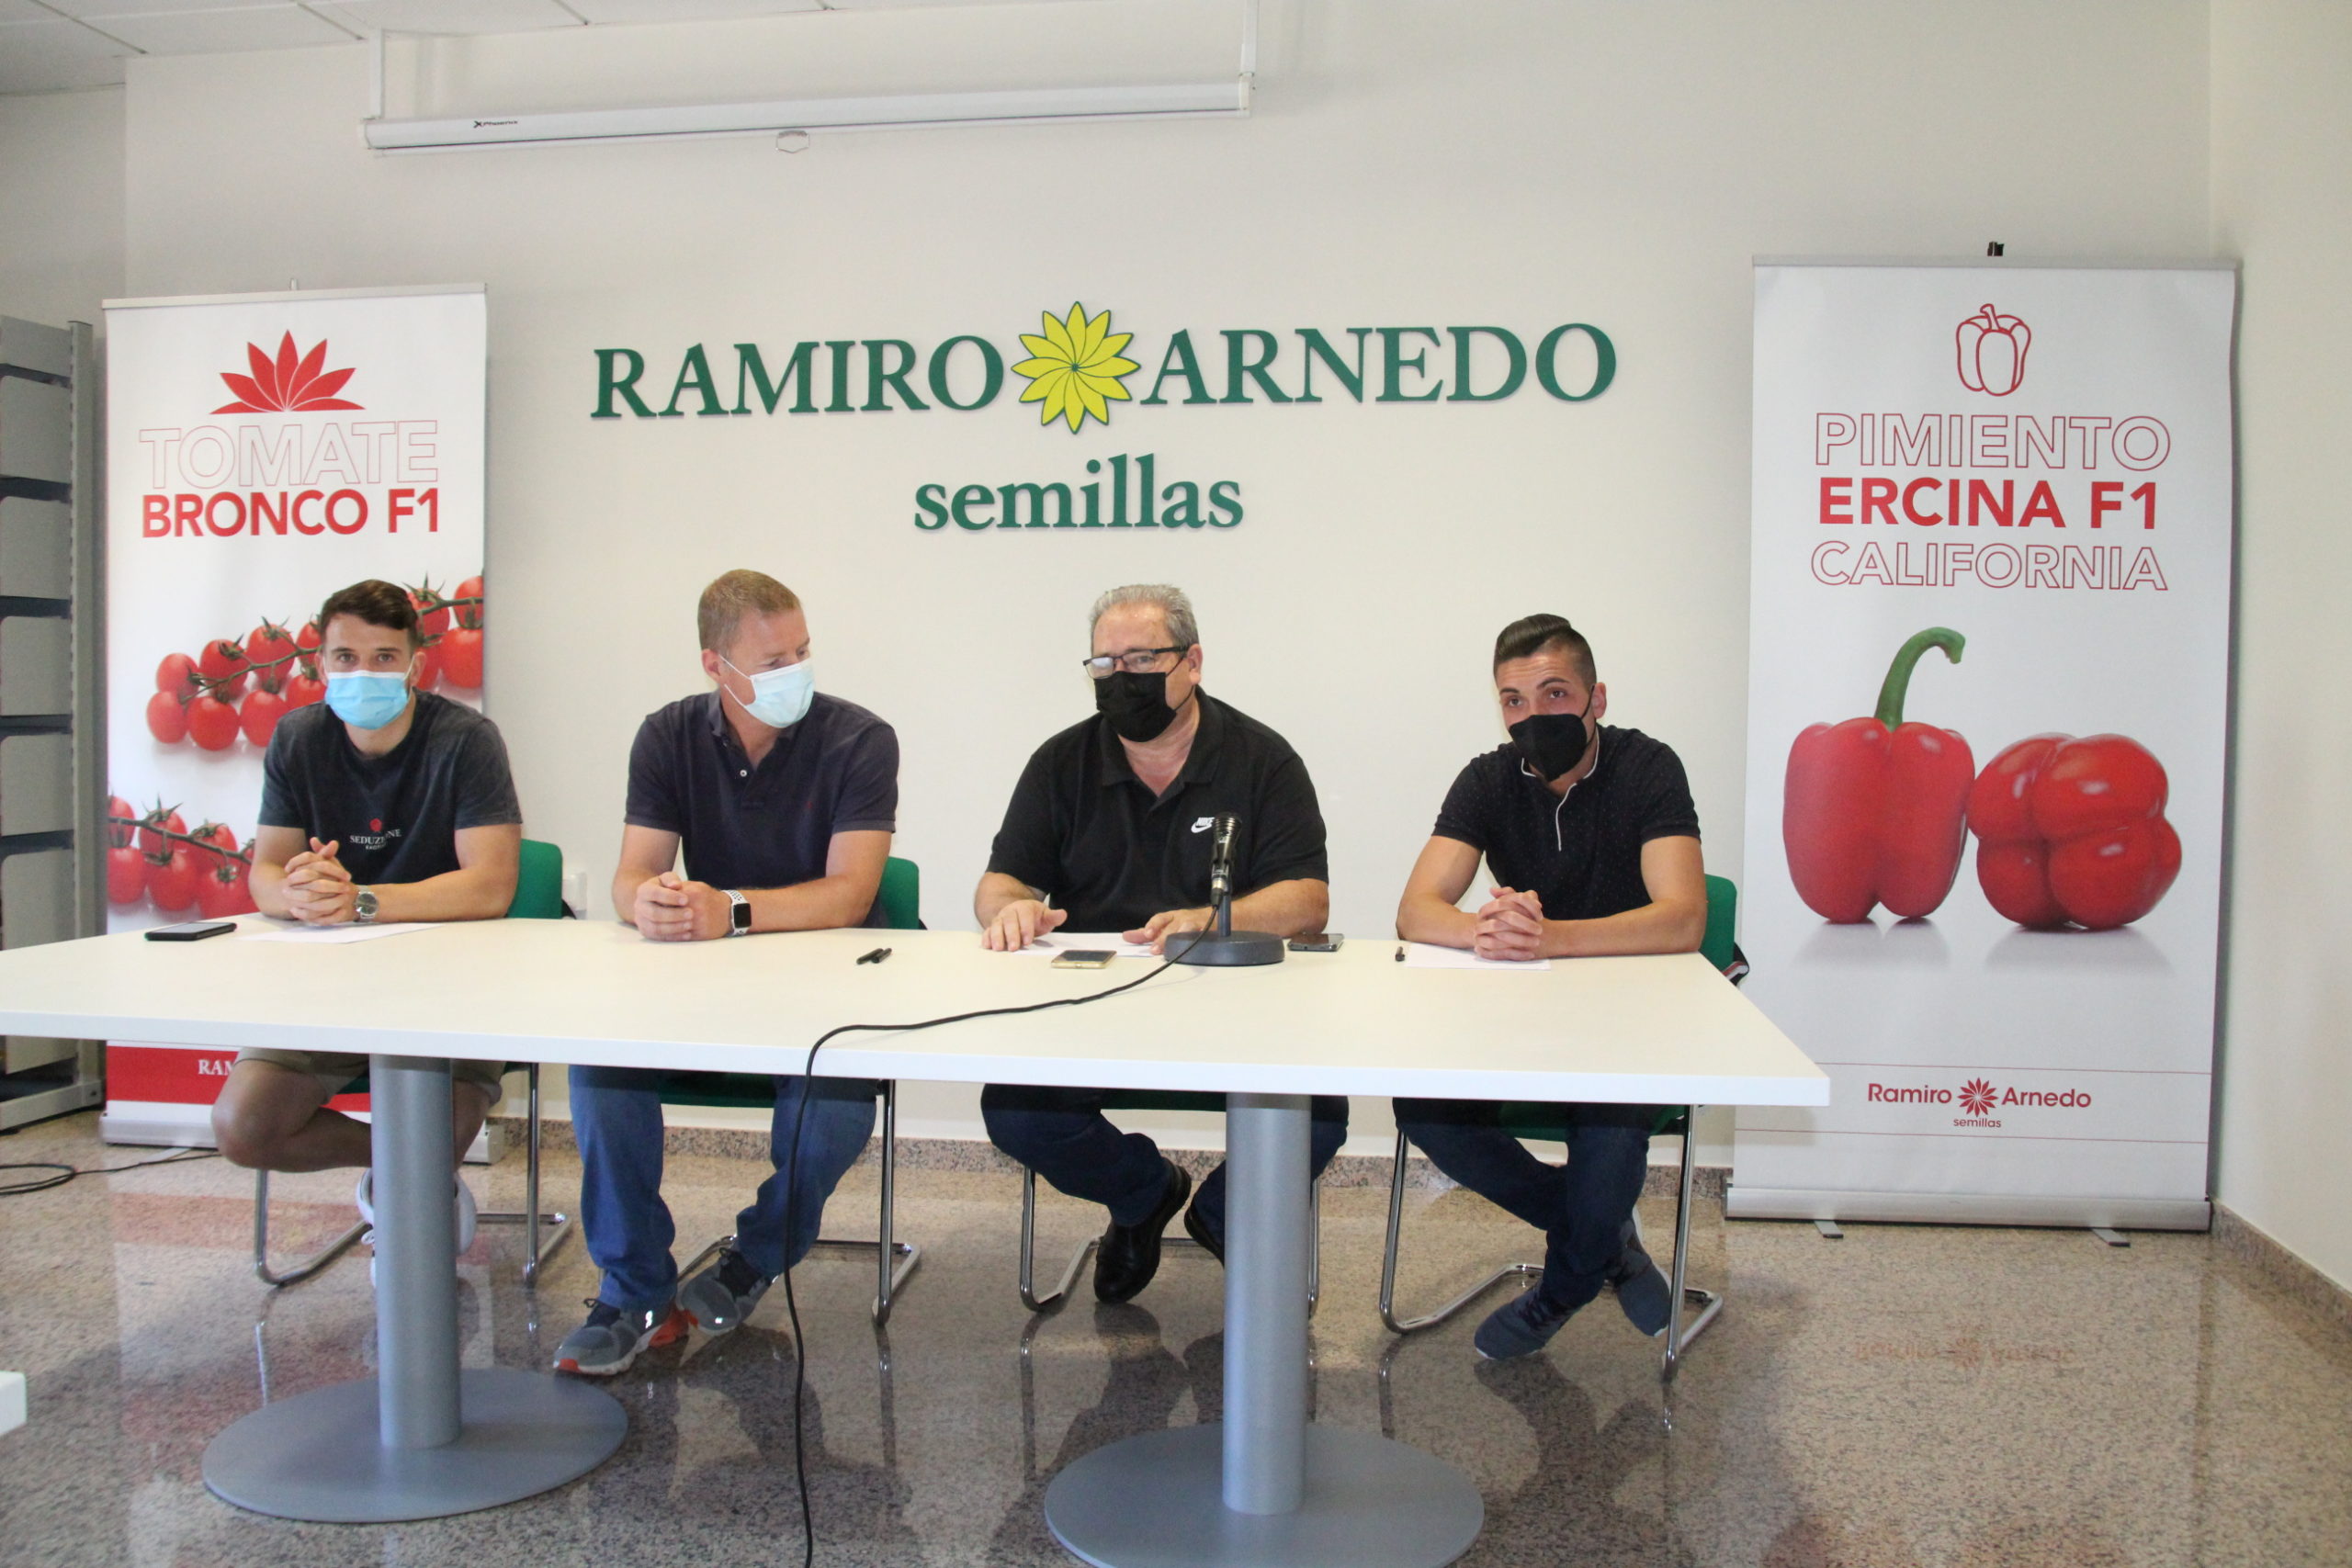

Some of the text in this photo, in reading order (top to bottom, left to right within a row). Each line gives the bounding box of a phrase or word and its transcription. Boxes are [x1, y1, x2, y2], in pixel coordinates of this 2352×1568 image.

[590, 322, 1617, 419] RAMIRO ARNEDO
[139, 420, 438, 490] TOMATE
[1815, 412, 2171, 471] PIMIENTO
[142, 488, 438, 538] BRONCO F1
[914, 453, 1244, 531] semillas
[1819, 477, 2156, 530] ERCINA F1
[1811, 540, 2169, 591] CALIFORNIA
[349, 829, 401, 844] SEDUZINE
[1196, 817, 1215, 827] NIKE
[1868, 1083, 2092, 1108] Ramiro Arnedo
[1953, 1118, 2002, 1128] semillas
